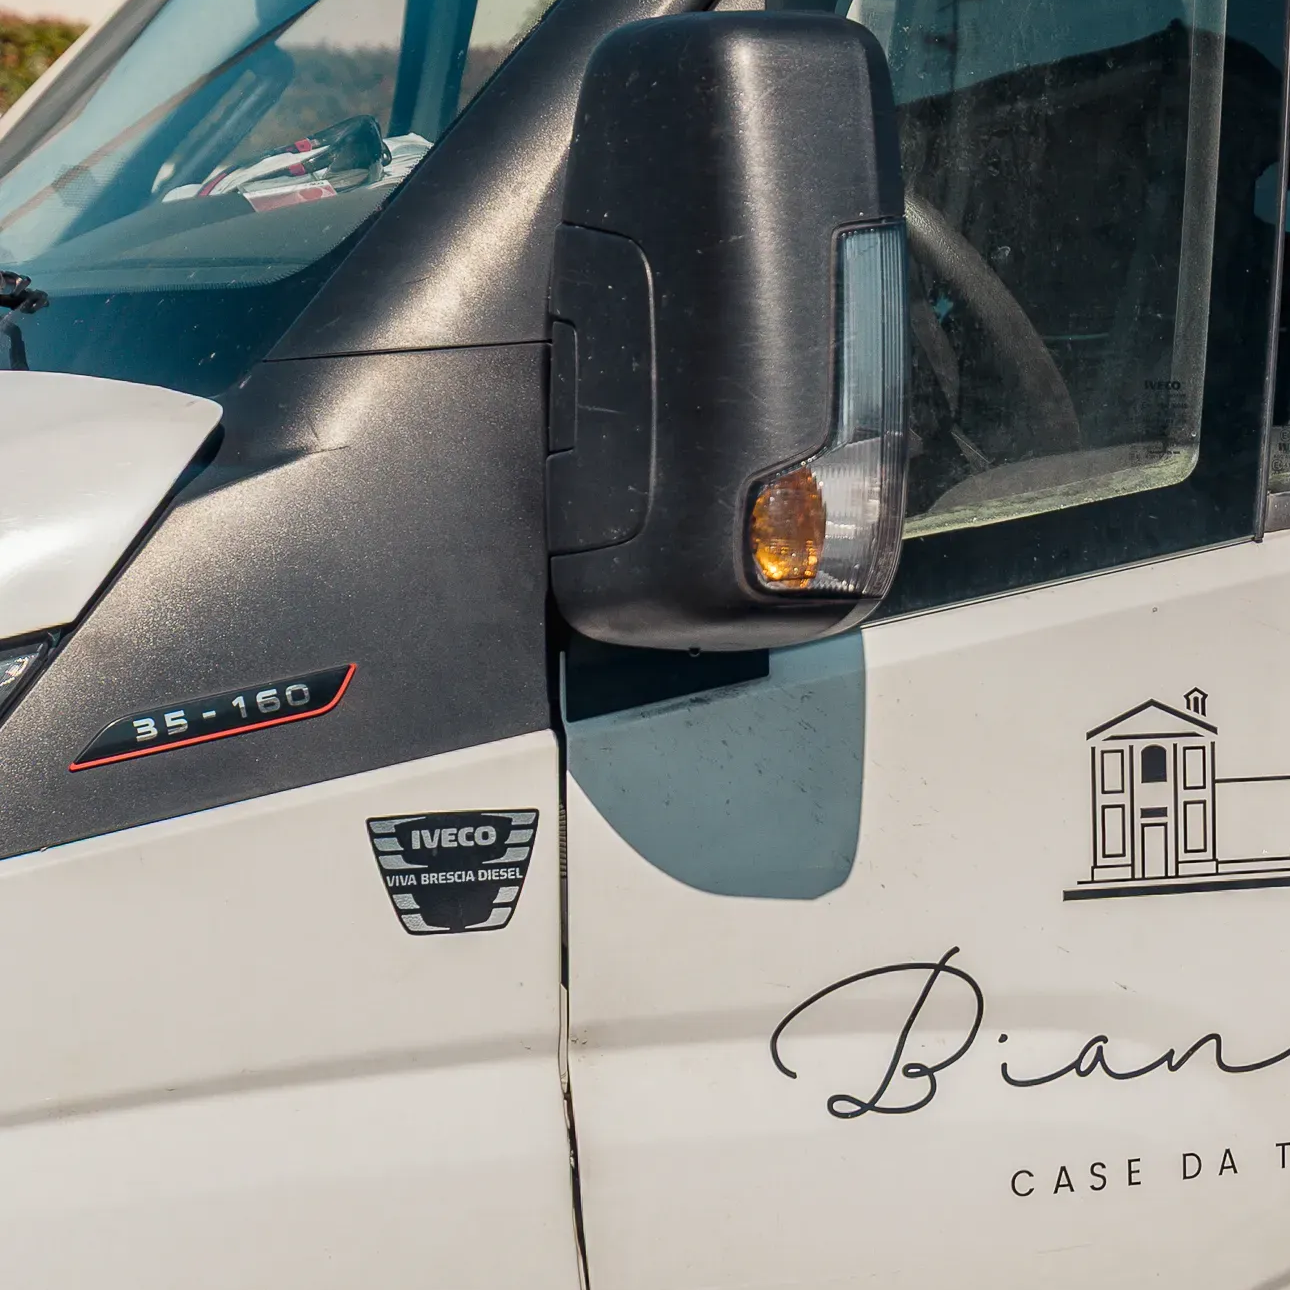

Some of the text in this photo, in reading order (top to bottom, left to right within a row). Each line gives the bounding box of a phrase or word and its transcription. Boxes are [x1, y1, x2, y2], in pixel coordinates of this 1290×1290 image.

[411, 825, 496, 851] IVECO
[386, 866, 524, 888] VIVA BRESCIA DIESEL
[1010, 1157, 1144, 1199] CASE
[1181, 1149, 1241, 1182] DA
